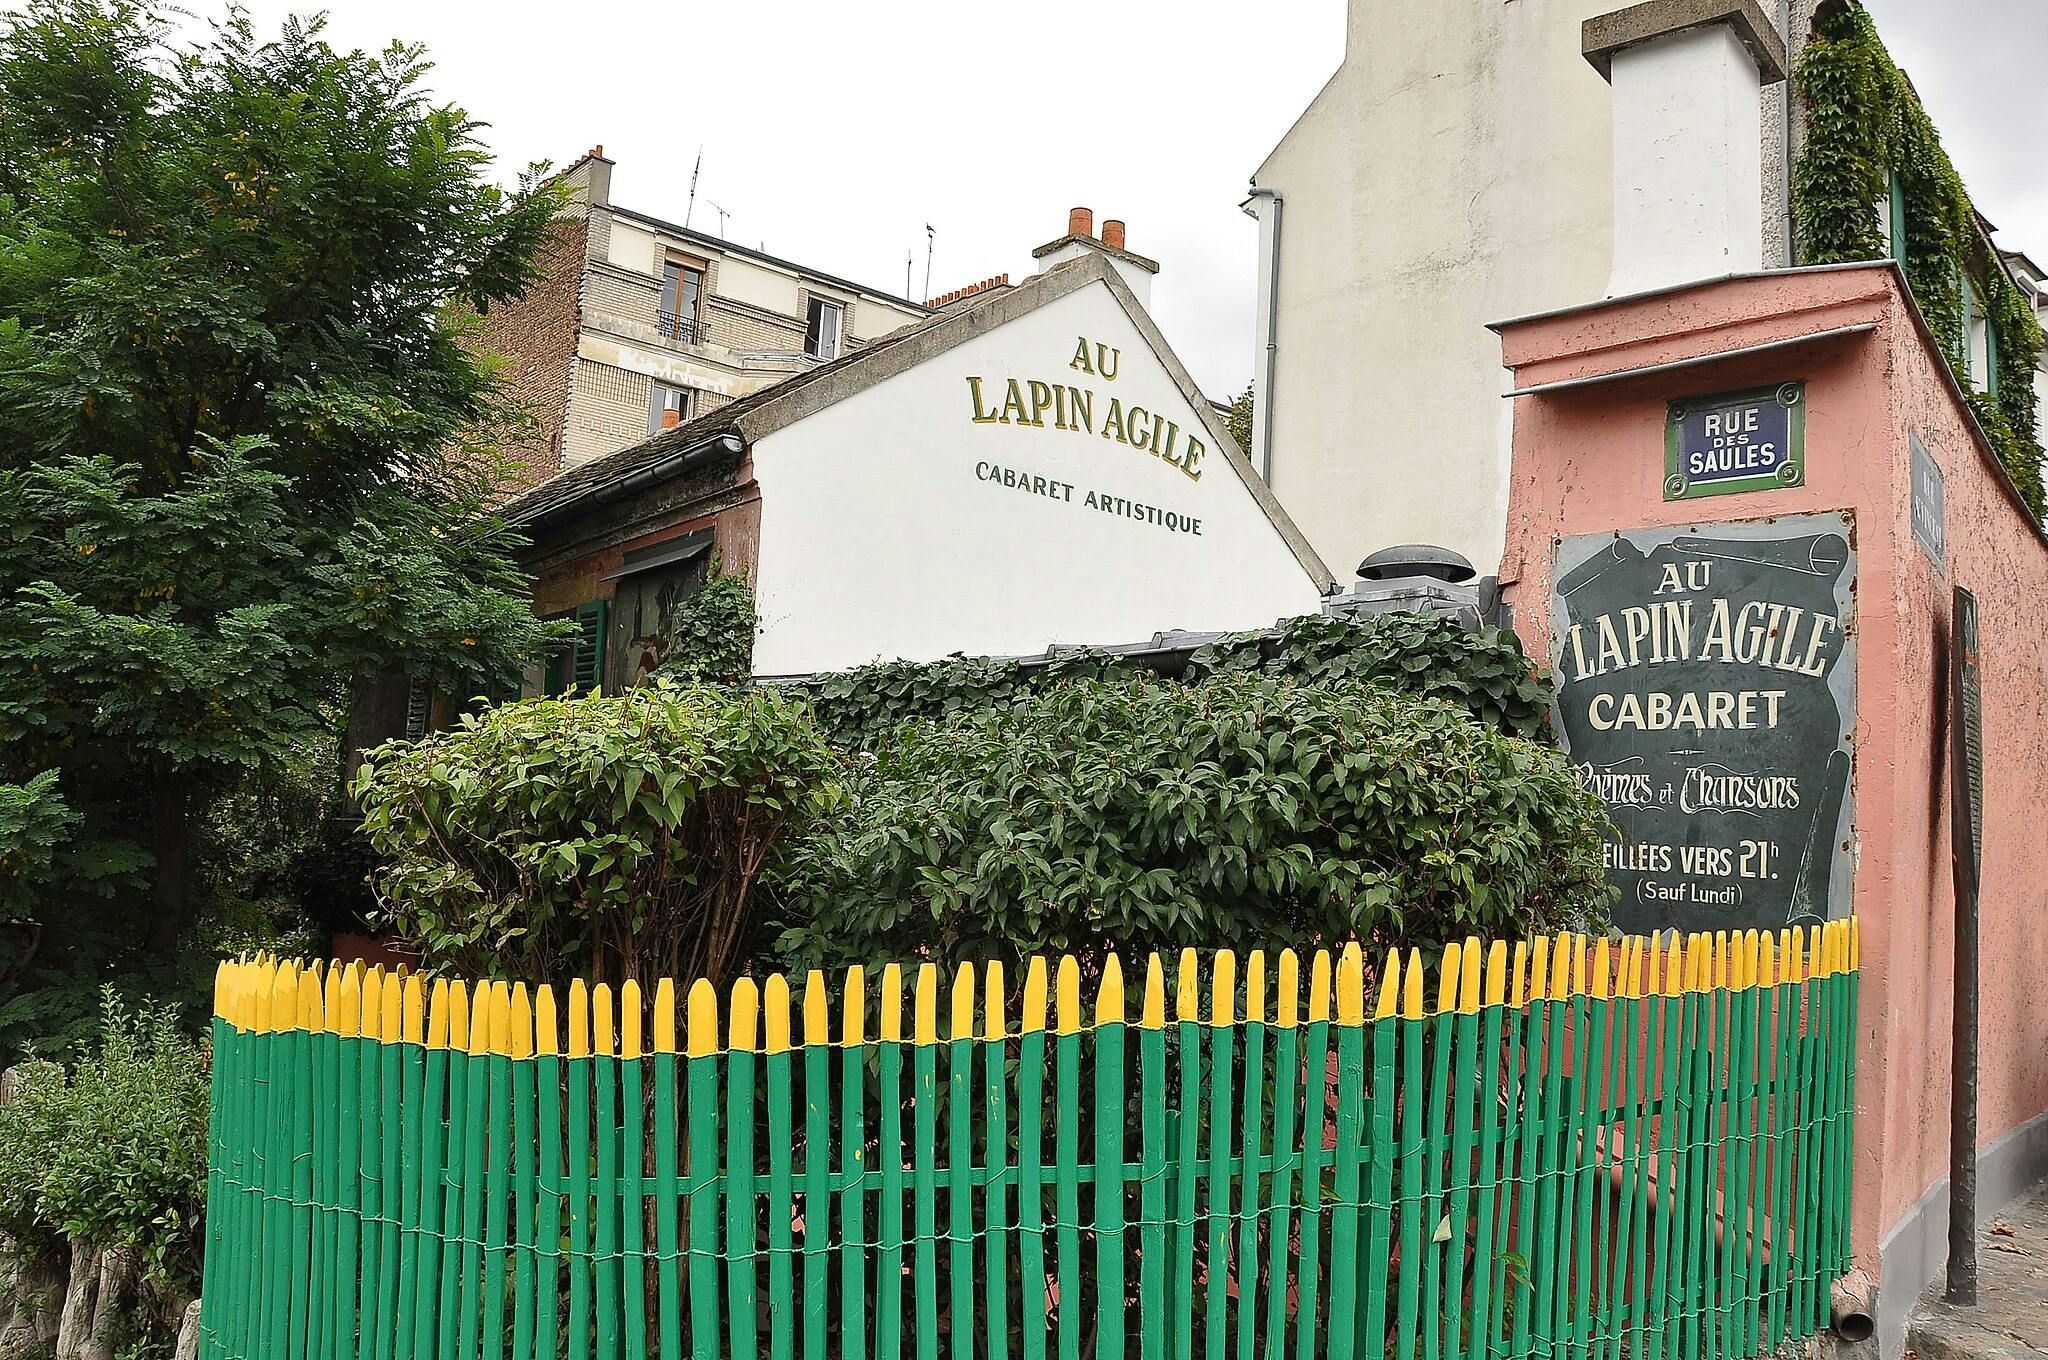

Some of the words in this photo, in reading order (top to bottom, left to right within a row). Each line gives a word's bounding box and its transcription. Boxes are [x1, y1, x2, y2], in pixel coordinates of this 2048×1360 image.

[1069, 336, 1121, 381] AU
[966, 376, 1094, 434] LAPIN
[1101, 397, 1206, 483] AGILE
[1705, 408, 1759, 437] RUE
[1713, 433, 1750, 448] DES
[1689, 442, 1776, 475] SAULES
[975, 461, 1075, 502] CABARET
[1083, 490, 1203, 537] ARTISTIQUE
[1653, 560, 1713, 595] AU
[1568, 600, 1694, 683] LAPIN
[1696, 598, 1837, 678] AGILE
[1588, 690, 1787, 731] CABARET
[1658, 783, 1675, 804] et
[1680, 767, 1800, 815] Chansons
[1602, 841, 1673, 872] EILLÉES
[1680, 846, 1733, 877] VERS
[1636, 877, 1687, 905] (Sauf
[1691, 883, 1744, 908] Lundi)
